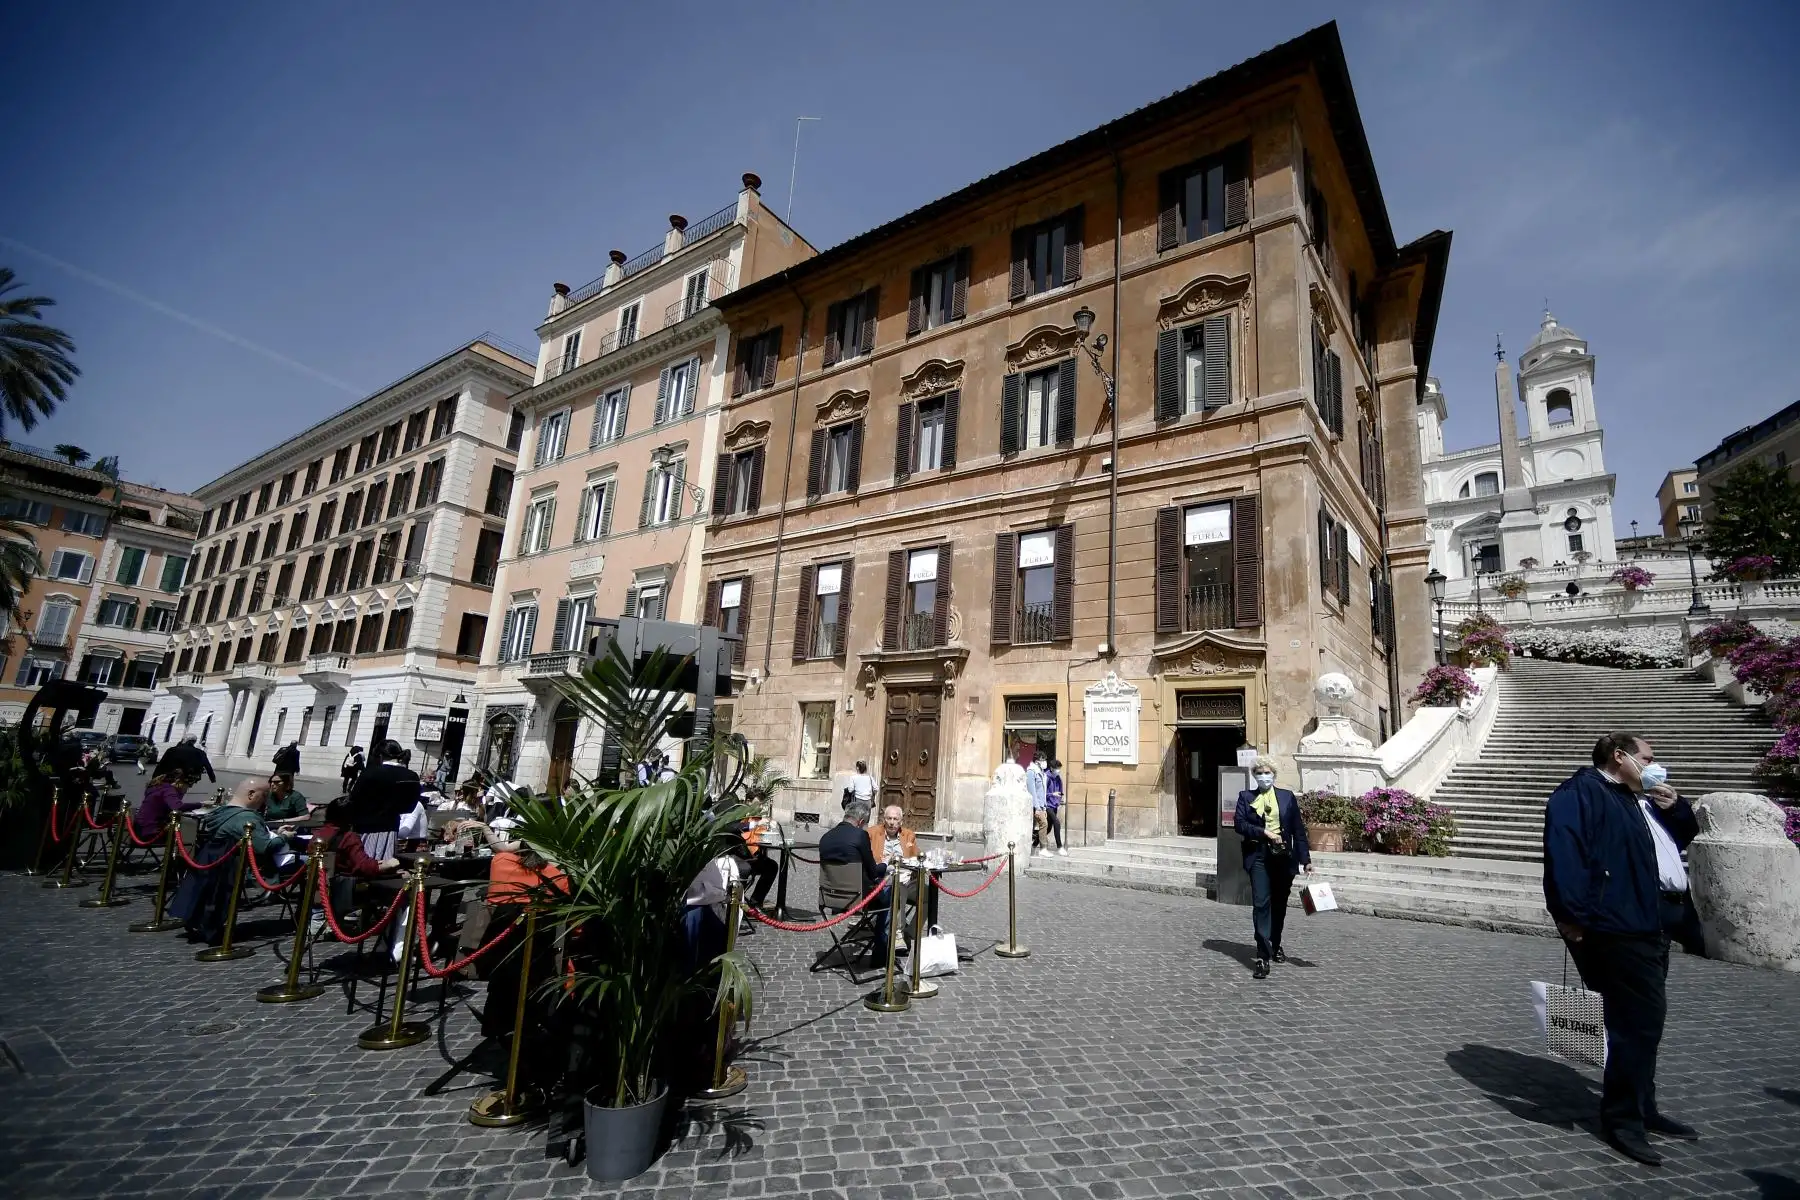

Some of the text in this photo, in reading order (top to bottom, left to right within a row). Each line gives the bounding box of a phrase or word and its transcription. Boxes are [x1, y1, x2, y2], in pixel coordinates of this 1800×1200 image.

[1192, 532, 1224, 542] FURLA
[1024, 556, 1049, 565] FURLA
[913, 571, 934, 579] FURLA
[1093, 705, 1130, 713] BABINGTON'S
[1100, 719, 1122, 730] TEA
[1093, 735, 1130, 746] ROOMS
[1551, 1015, 1600, 1037] VOLTAIRE
